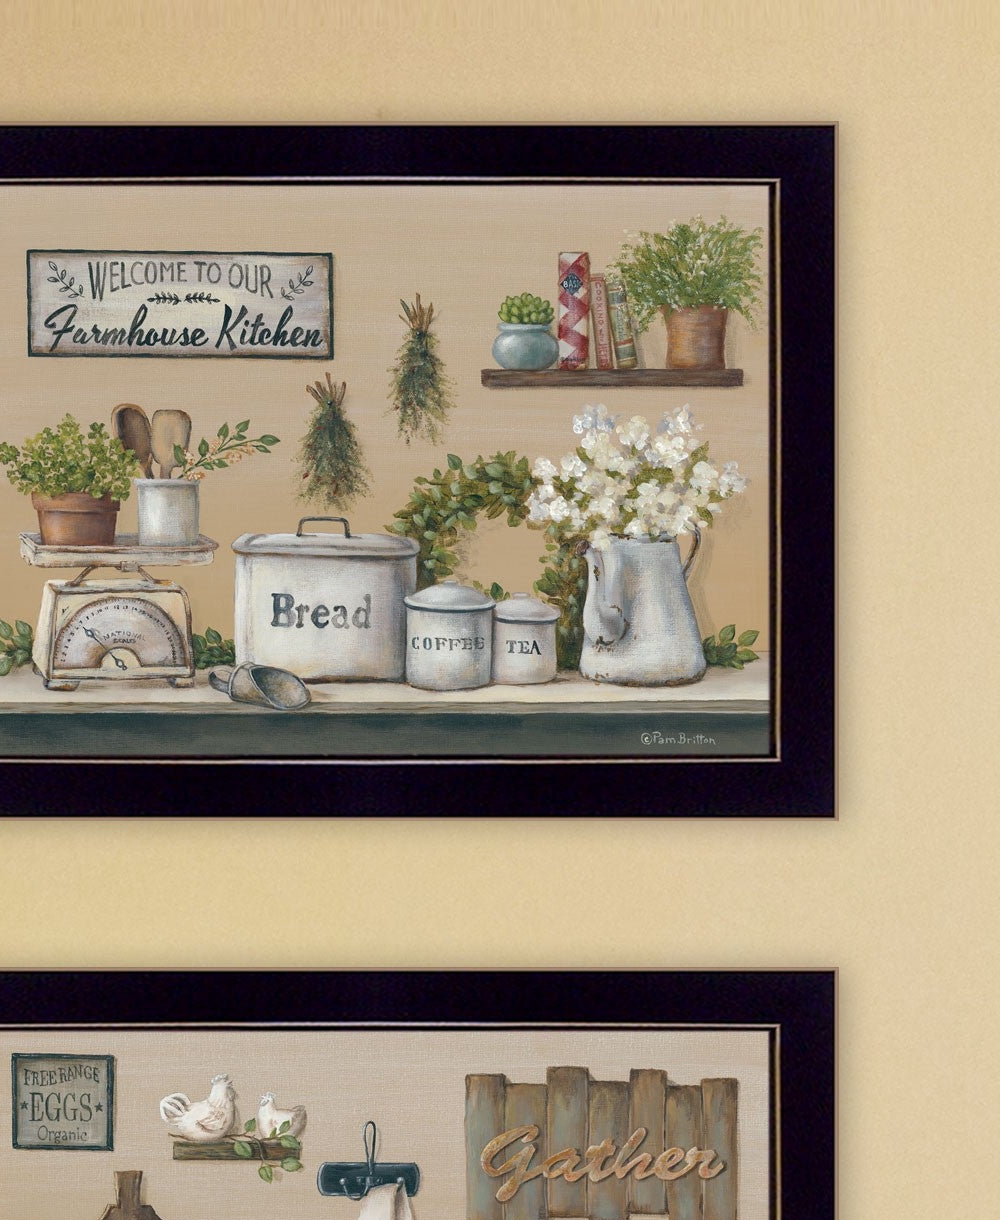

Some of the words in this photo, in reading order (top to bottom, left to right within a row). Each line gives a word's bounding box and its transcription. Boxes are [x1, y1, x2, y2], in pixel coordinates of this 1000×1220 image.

[88, 260, 186, 302] WELCOME
[194, 261, 222, 284] TO
[228, 263, 274, 299] OUR
[44, 303, 209, 351] Farmhouse
[215, 303, 323, 350] Kitchen
[270, 592, 372, 629] Bread
[103, 630, 146, 641] NATIONAL
[411, 636, 485, 651] COFFEE
[505, 639, 541, 655] TEA
[678, 732, 716, 745] Britton
[23, 1068, 57, 1087] FREE
[58, 1064, 100, 1083] RANGE
[29, 1092, 93, 1122] EGGS
[37, 1125, 87, 1144] Organic
[480, 1123, 728, 1202] Gather
